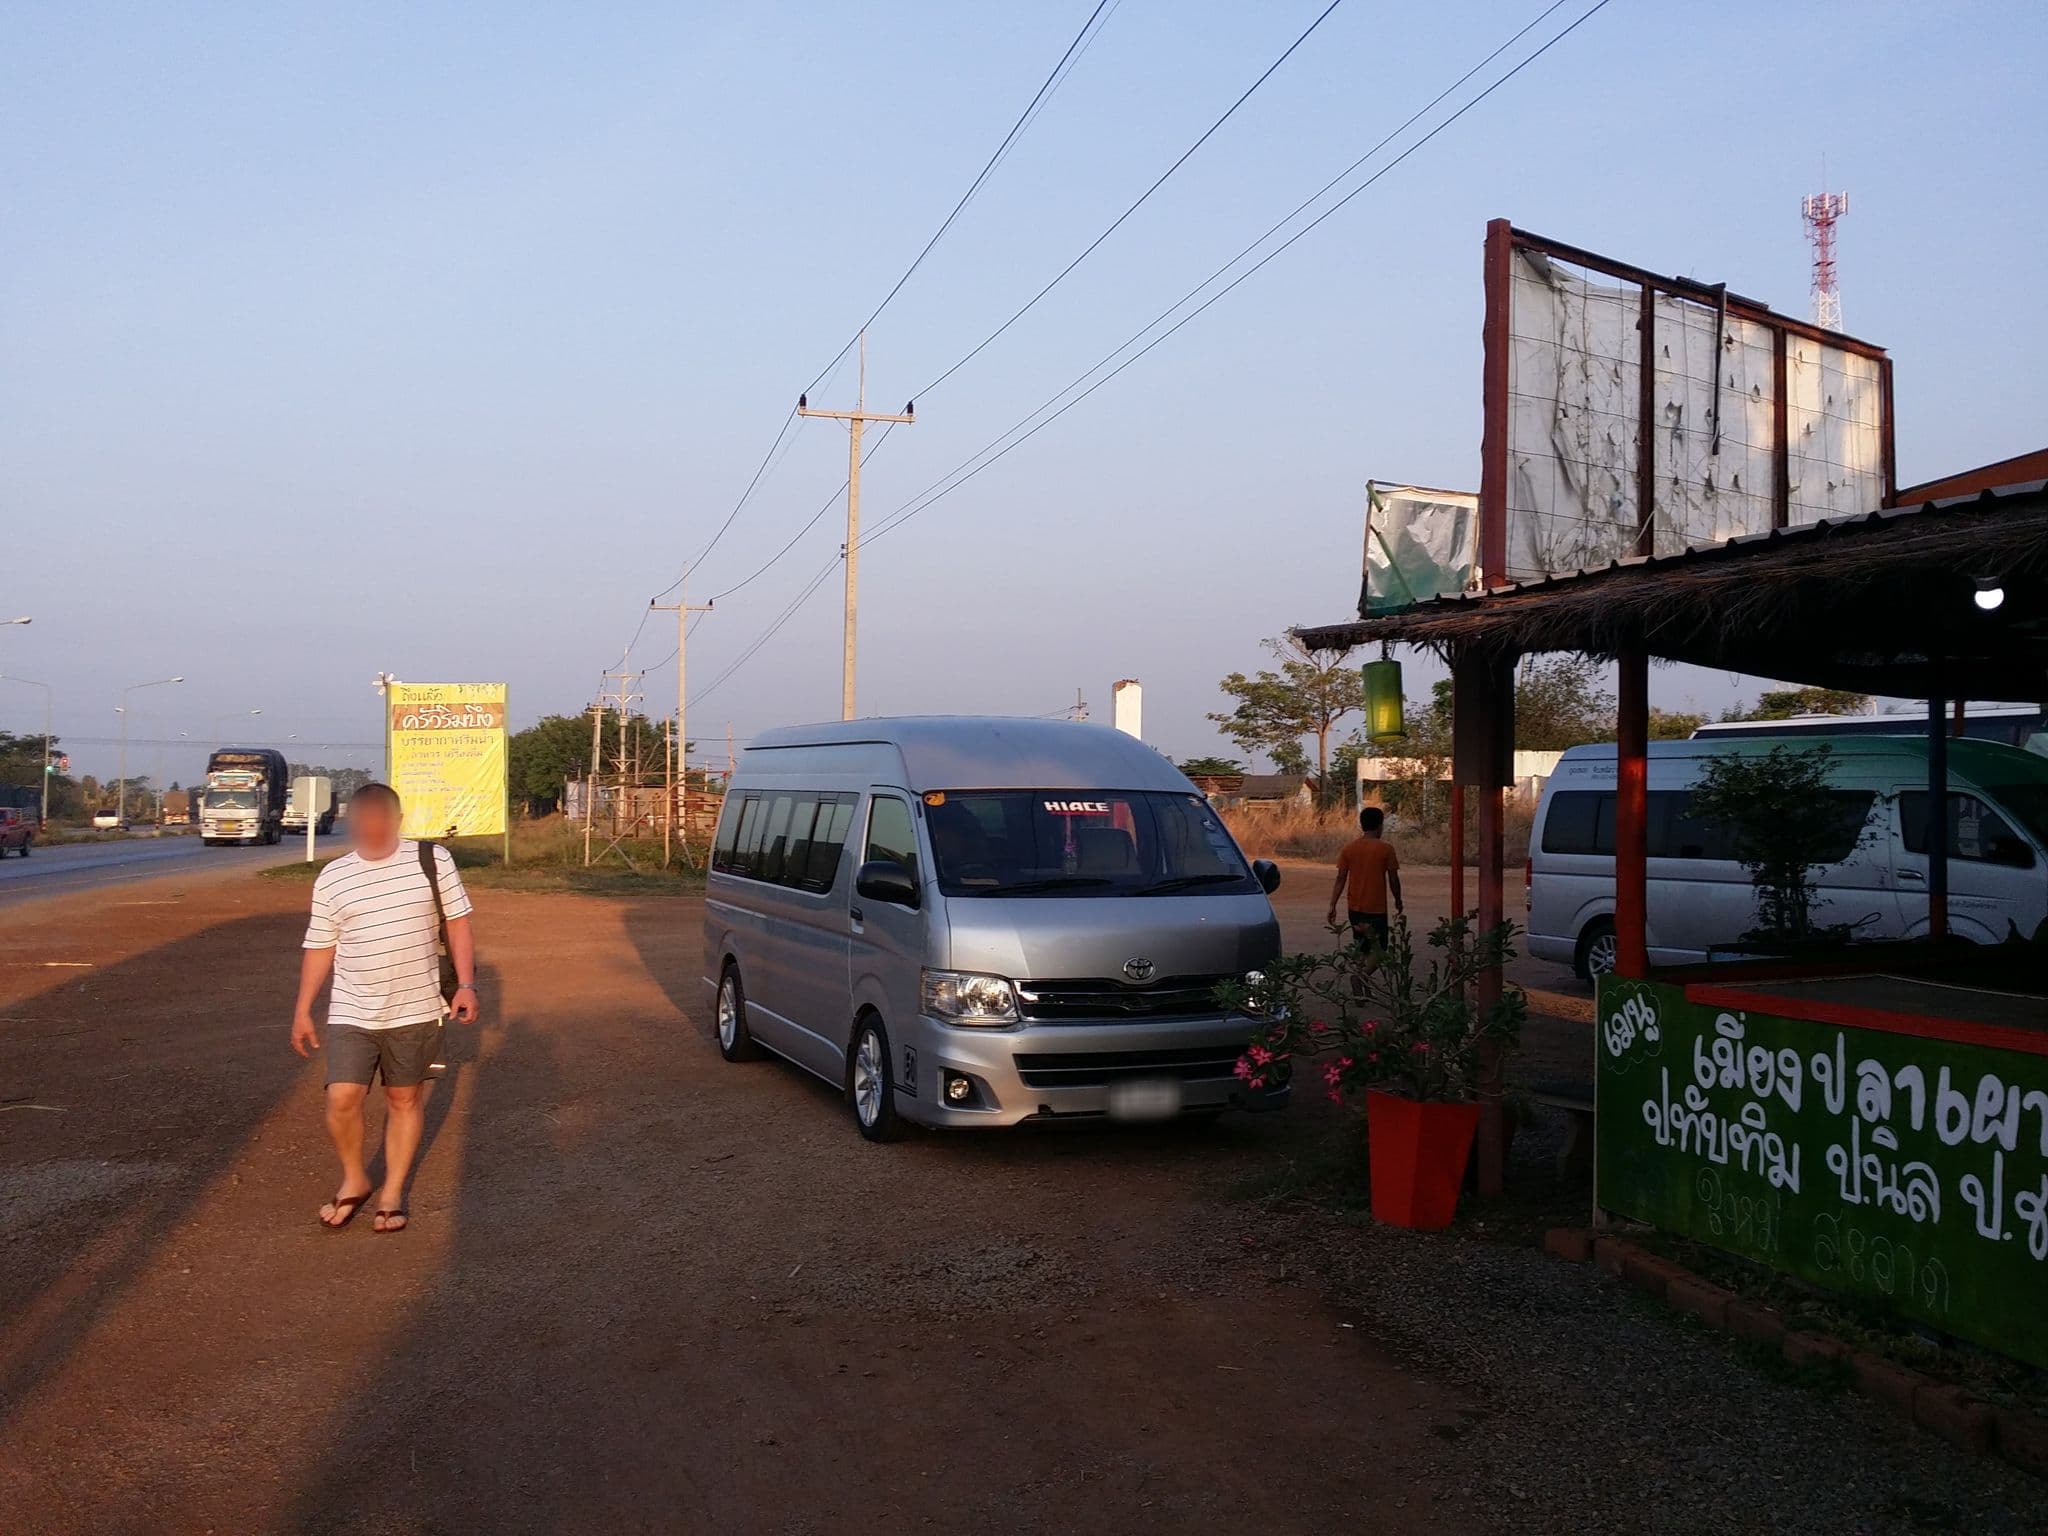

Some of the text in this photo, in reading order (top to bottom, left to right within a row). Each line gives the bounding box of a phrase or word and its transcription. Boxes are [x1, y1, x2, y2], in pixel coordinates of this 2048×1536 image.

[402, 704, 494, 729] ครัวริมบึง
[1043, 801, 1110, 812] HIACE
[1603, 992, 1660, 1058] เมนู
[1825, 1115, 1942, 1225] ป.นิล
